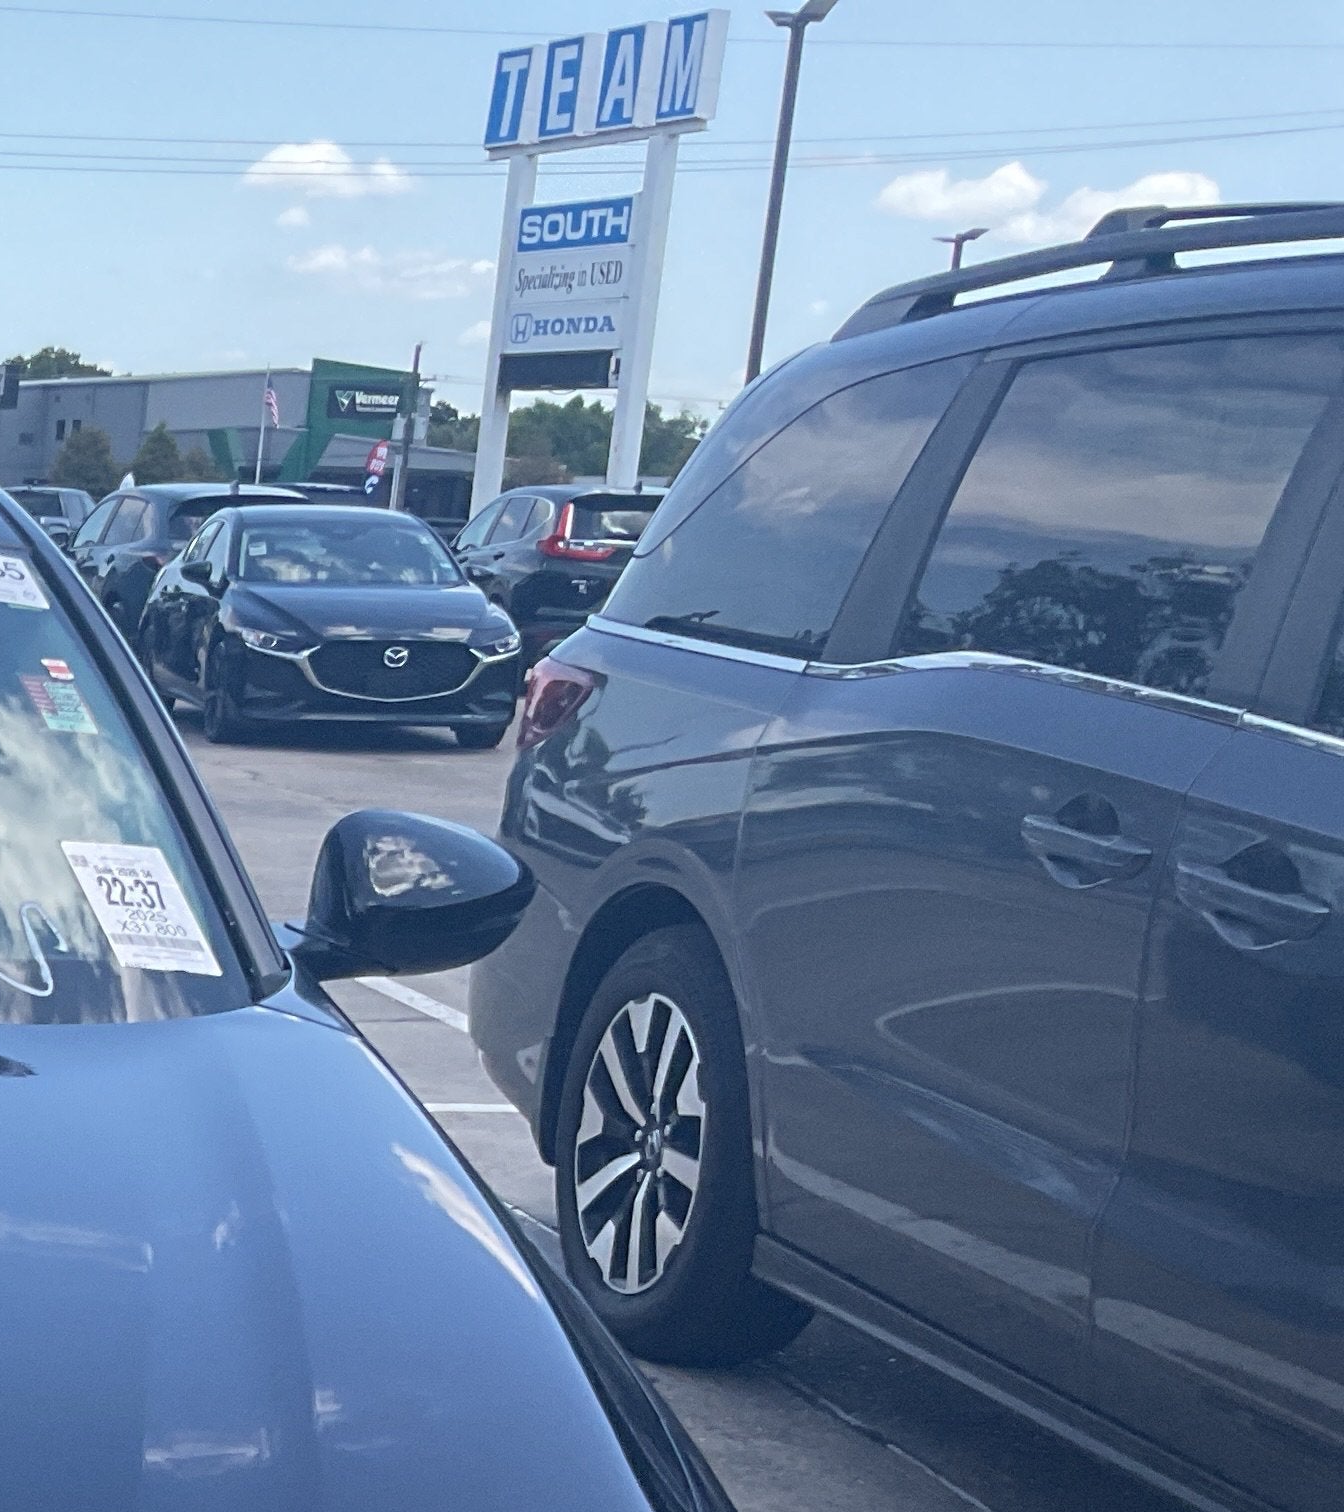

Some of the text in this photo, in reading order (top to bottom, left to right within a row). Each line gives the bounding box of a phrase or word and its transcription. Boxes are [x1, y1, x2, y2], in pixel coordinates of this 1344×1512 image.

[499, 19, 708, 138] TEAM
[520, 206, 630, 245] SOUTH
[515, 260, 623, 298] Specializing in USED
[532, 315, 616, 337] HONDA
[96, 876, 166, 910] 22:37
[125, 908, 168, 923] 2025
